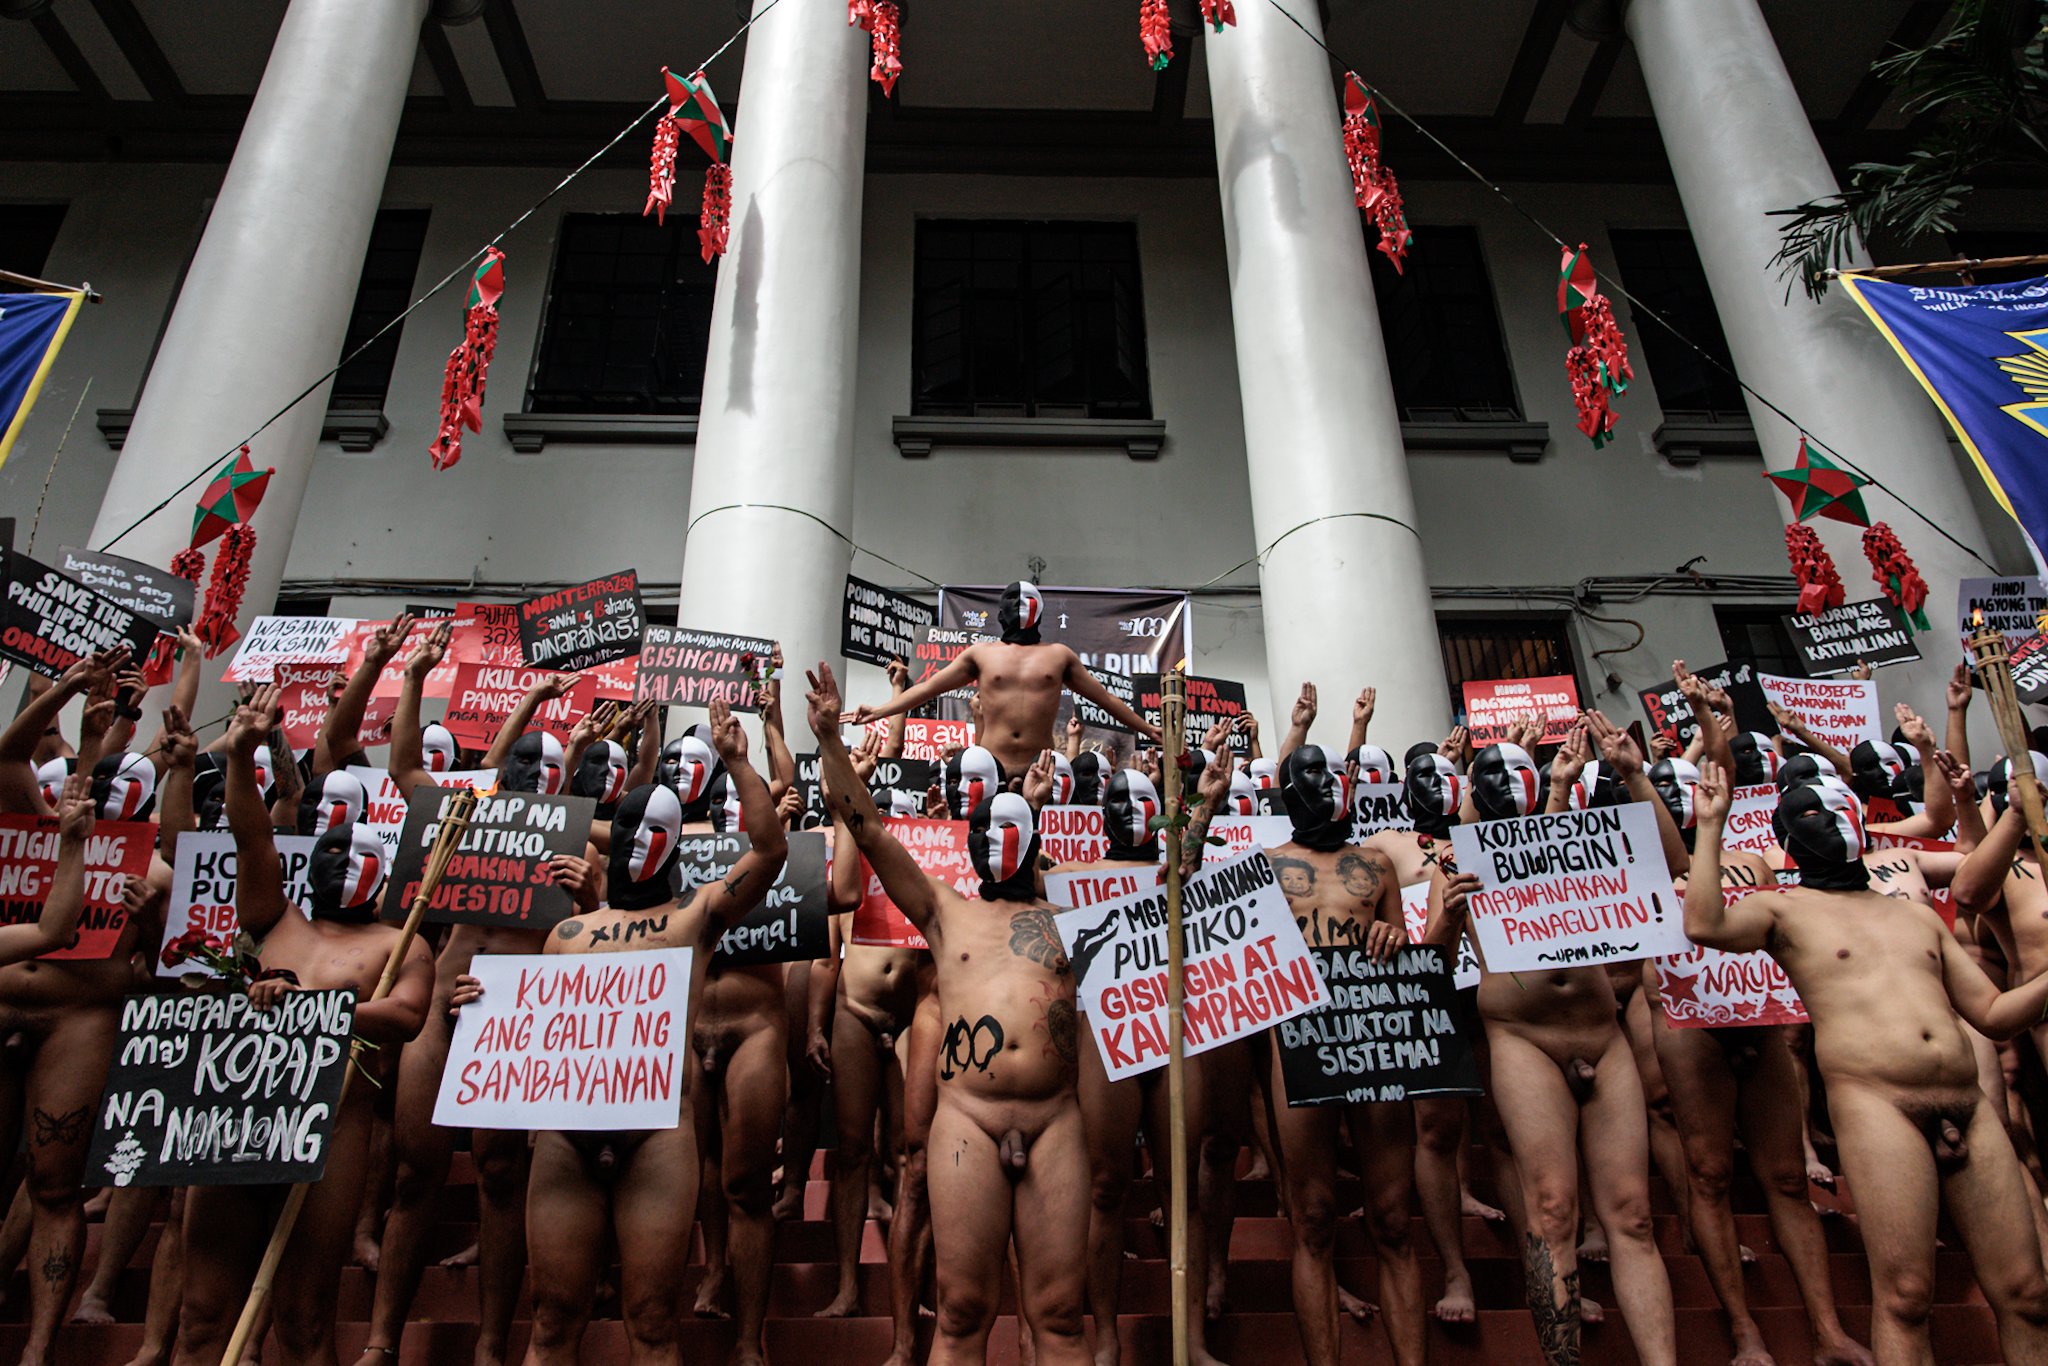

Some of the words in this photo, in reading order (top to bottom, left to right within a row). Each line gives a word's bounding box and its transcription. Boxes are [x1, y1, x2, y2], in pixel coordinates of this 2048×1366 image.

[36, 572, 94, 614] SAVE
[96, 597, 134, 634] THE
[847, 582, 885, 609] PONDO
[891, 598, 933, 627] SERBISYO
[1992, 581, 2025, 596] HINDI
[849, 603, 882, 628] HINDI
[884, 615, 898, 635] SA
[1860, 602, 1883, 617] SA
[37, 618, 97, 658] FROM
[254, 619, 342, 637] WASAKIN,
[646, 628, 670, 644] MGA
[673, 631, 730, 649] BUWAYANG
[731, 640, 772, 656] PULITIKO
[850, 624, 871, 646] NG
[1809, 622, 1856, 643] BAHA
[1857, 616, 1892, 633] ANG
[243, 637, 330, 654] PUKSAIN
[641, 646, 738, 674] GISINGIN
[1186, 680, 1218, 697] HIYA
[1494, 684, 1531, 696] HINDI
[1761, 677, 1801, 694] GHOST
[1804, 683, 1866, 699] PROJECTS
[1201, 699, 1242, 716] KAYO!
[1470, 709, 1496, 727] ANG
[1809, 714, 1828, 727] NG
[1830, 714, 1866, 729] BAYAN
[1471, 726, 1493, 741] MGA
[437, 795, 525, 824] RAP
[526, 803, 567, 832] NA
[421, 823, 552, 861] PLITIKO,
[1475, 807, 1621, 853] KORAPSYON
[679, 835, 740, 862] sagin
[194, 851, 308, 880] KOP
[421, 854, 526, 884] SBAKIN
[1123, 900, 1168, 933] MGA
[1181, 852, 1275, 918] BUWAYANG
[589, 914, 668, 948] XIMU
[1114, 899, 1259, 980] PULTIKO:
[1243, 934, 1277, 978] AT
[1310, 951, 1395, 981] SAGIN
[1398, 949, 1445, 976] ANG
[516, 962, 666, 1011] KUMUKULO
[1702, 957, 1792, 997] NAKULO
[1305, 982, 1396, 1015] ADENA
[1397, 982, 1430, 1005] NG
[474, 1013, 534, 1054] ANG
[543, 1010, 624, 1052] GALIT
[632, 1010, 671, 1049] NG
[1280, 1010, 1415, 1050] BALUKTOT
[1422, 1008, 1457, 1038] NA
[193, 1032, 341, 1102] KORAP
[1317, 1038, 1442, 1077] SISTEMA!
[456, 1053, 674, 1106] SAMBAYANAN
[104, 1088, 165, 1130] NA
